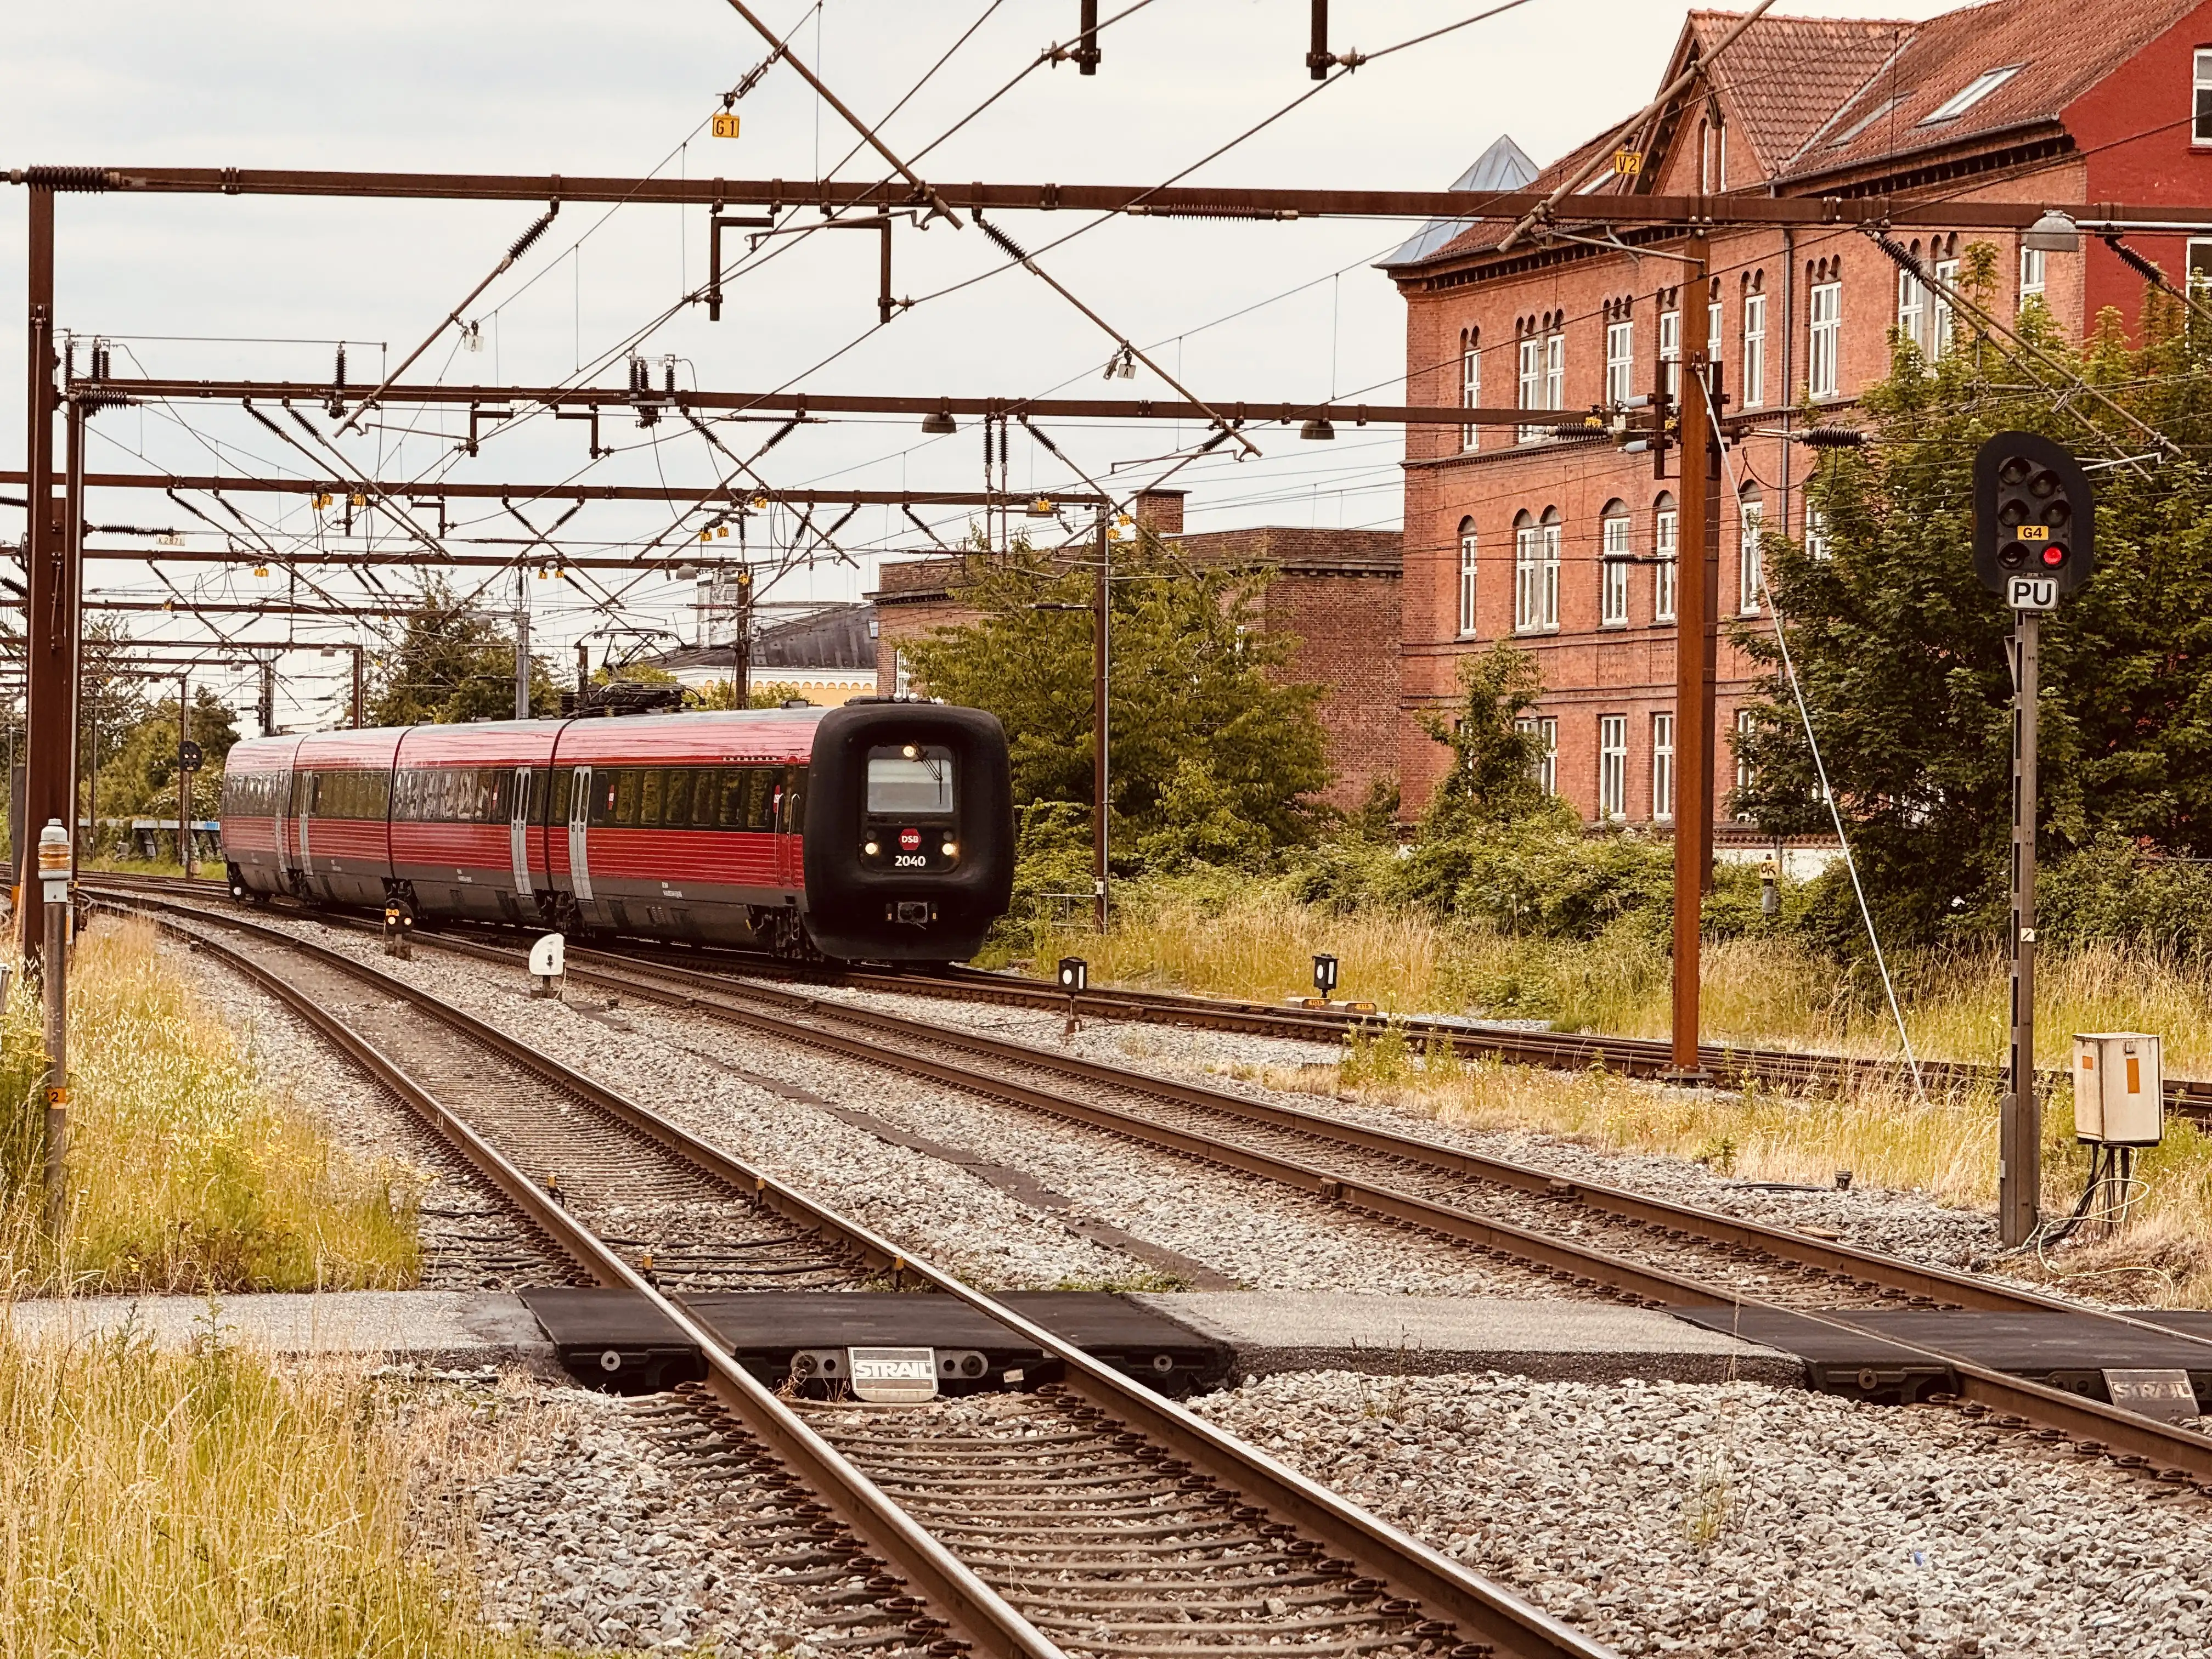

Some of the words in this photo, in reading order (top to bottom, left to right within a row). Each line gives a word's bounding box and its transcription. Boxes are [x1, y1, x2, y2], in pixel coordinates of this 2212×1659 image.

[1619, 155, 1637, 172] V2
[471, 339, 476, 349] A
[1124, 368, 1128, 377] A
[1039, 501, 1047, 510] G2
[2023, 527, 2042, 538] G4
[2013, 582, 2052, 606] PU
[895, 855, 926, 866] 2040
[51, 1091, 59, 1102] 2
